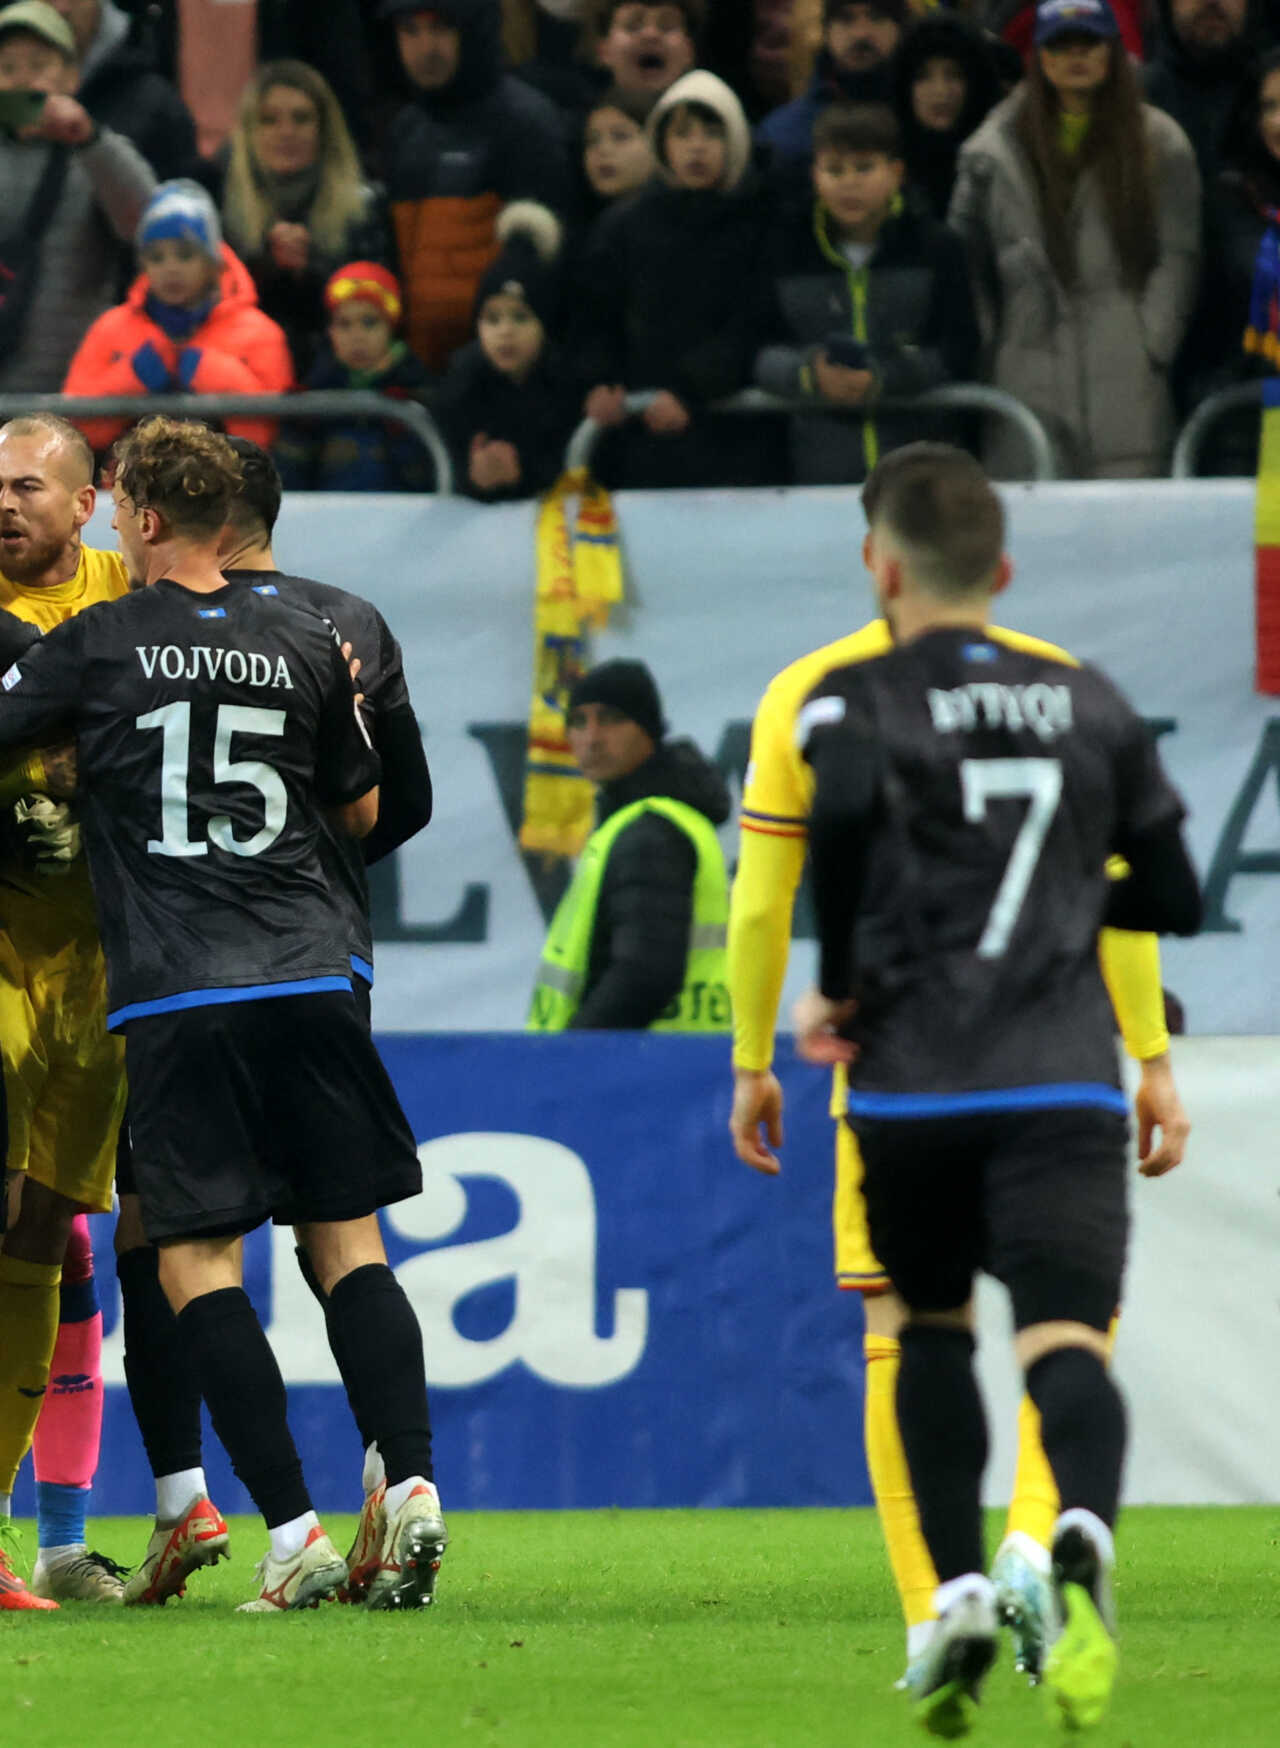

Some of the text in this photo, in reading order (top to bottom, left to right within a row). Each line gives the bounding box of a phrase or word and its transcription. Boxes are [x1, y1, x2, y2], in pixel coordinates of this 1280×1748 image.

[135, 645, 293, 689] VOJVODA
[136, 700, 288, 857] 15
[960, 758, 1063, 959] 7
